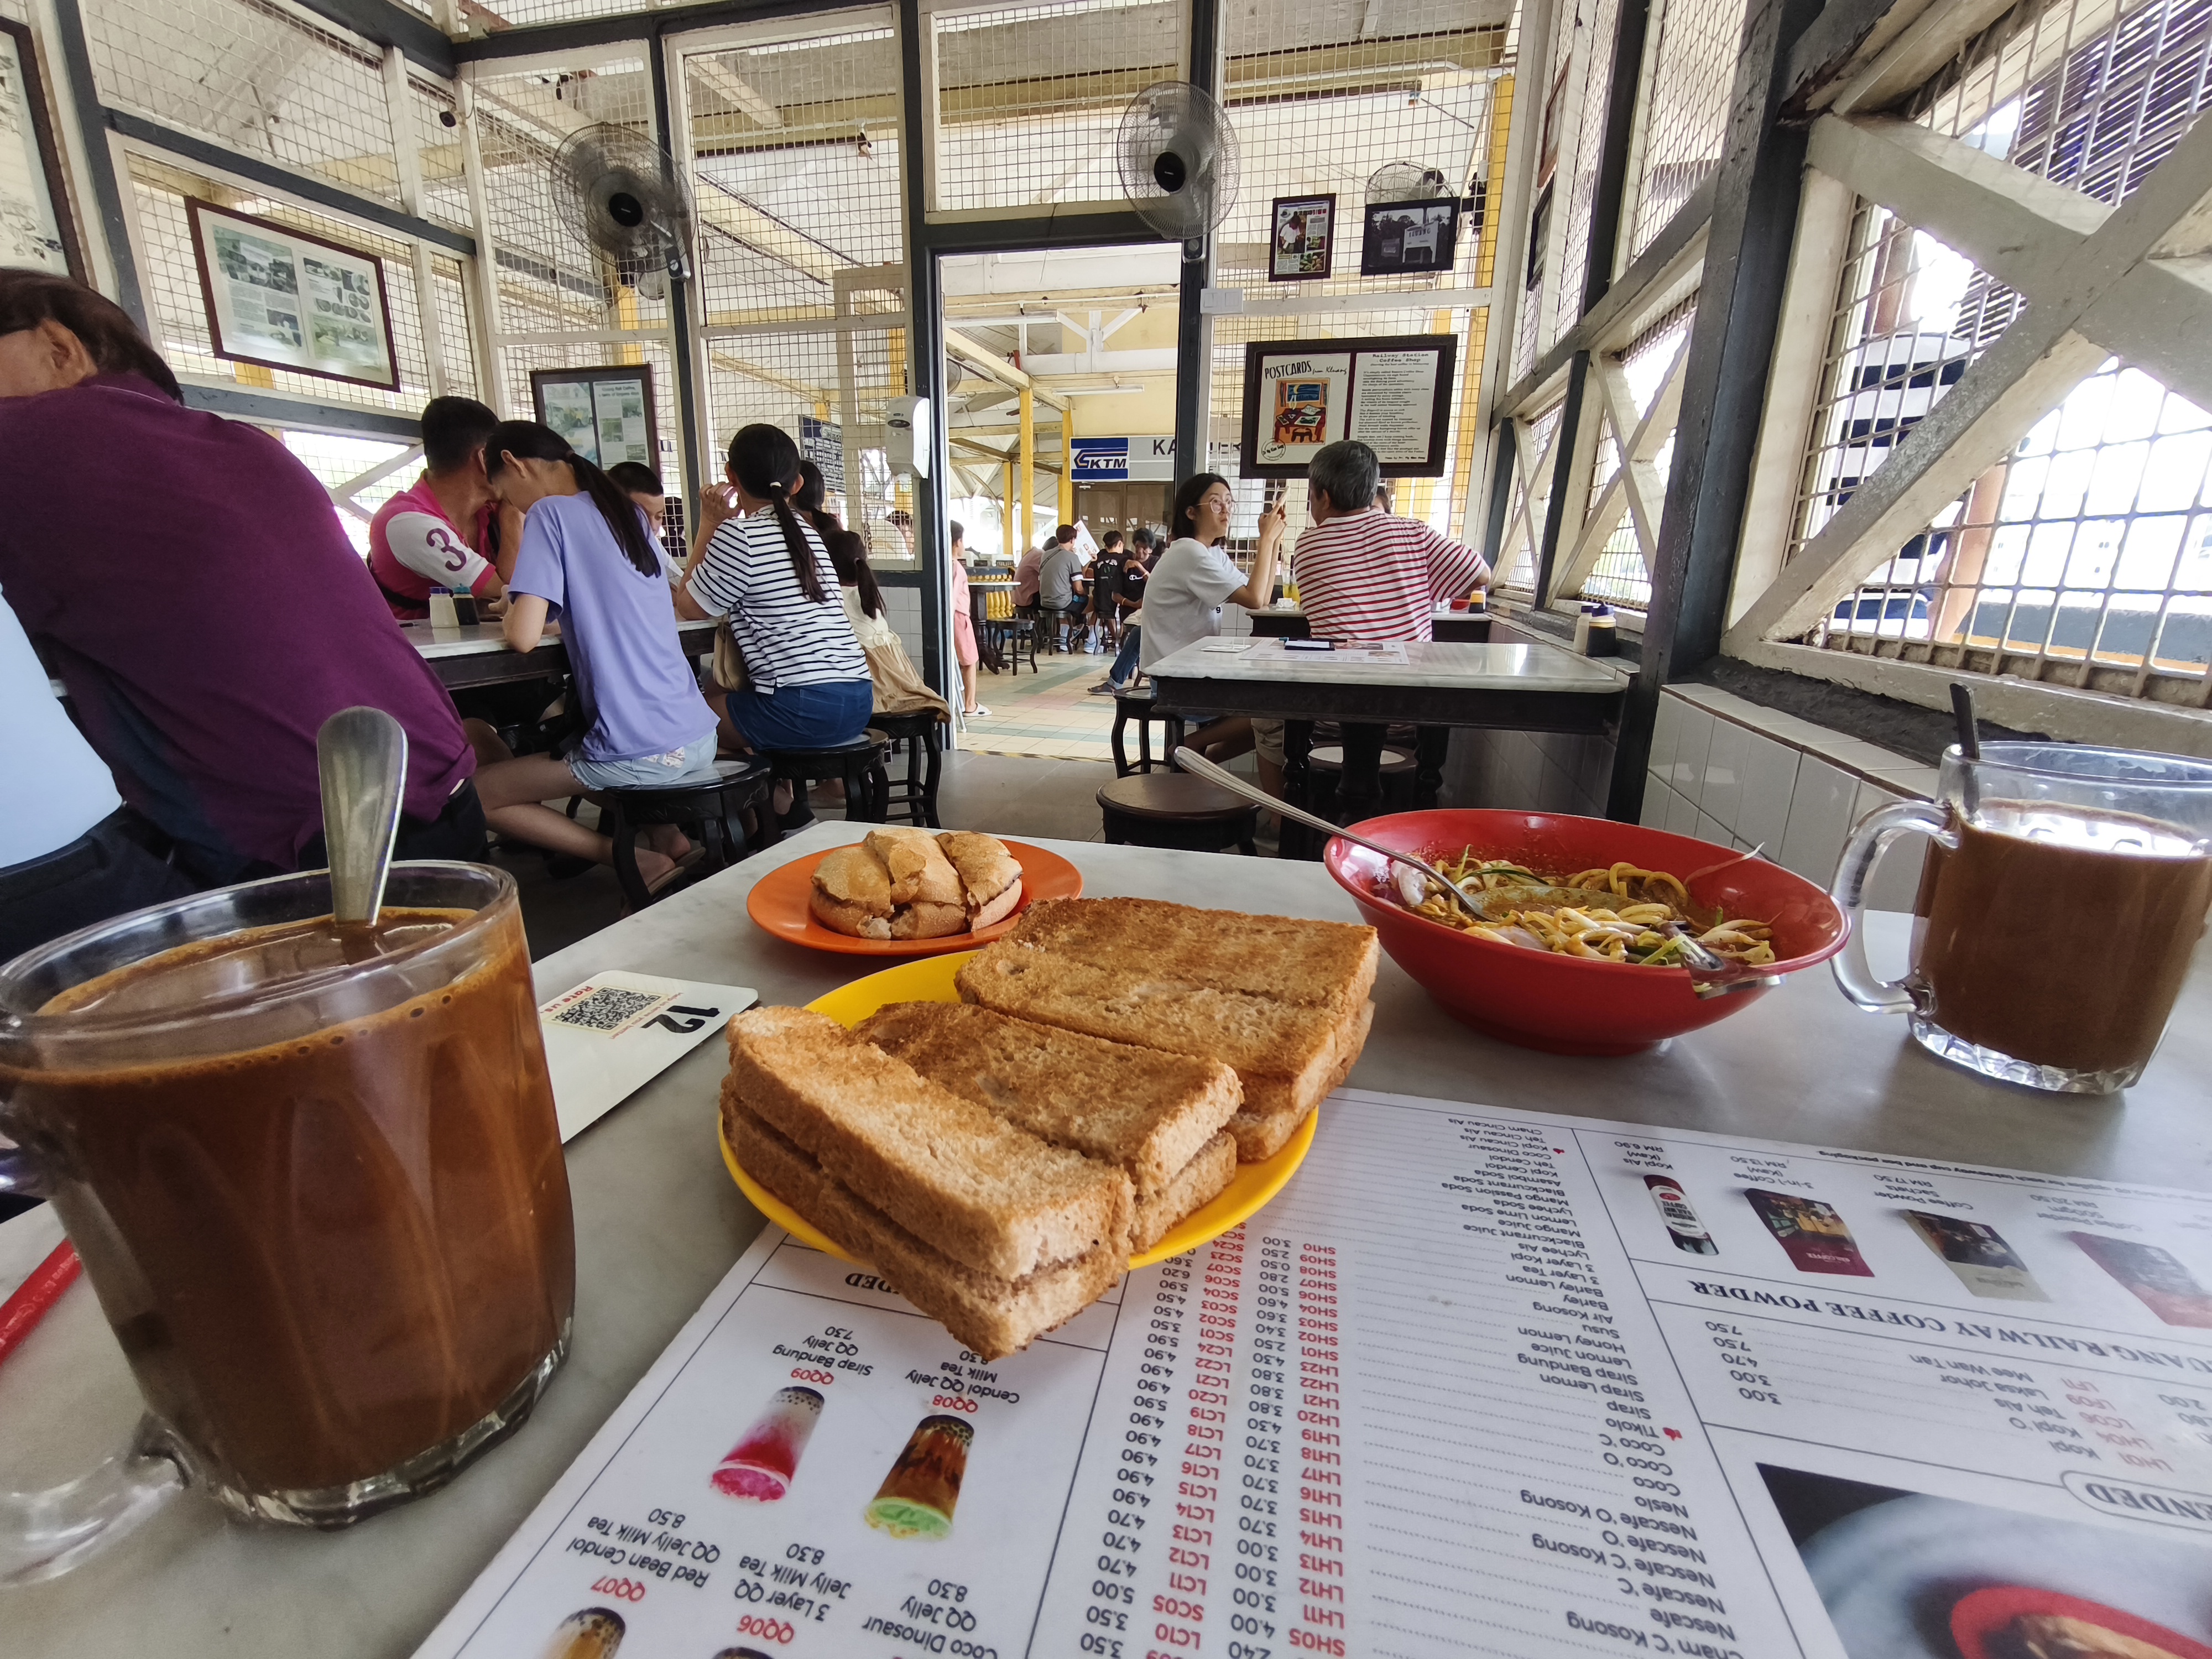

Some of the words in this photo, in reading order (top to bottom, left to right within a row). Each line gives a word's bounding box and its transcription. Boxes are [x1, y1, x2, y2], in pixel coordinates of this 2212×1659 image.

[1265, 361, 1312, 380] POSTCARDS
[1089, 458, 1126, 469] KTM
[426, 528, 467, 571] 3
[640, 1005, 720, 1034] 12
[1463, 1224, 1498, 1236] Juice
[1498, 1219, 1532, 1230] Juice
[1535, 1224, 1580, 1238] Mango
[1500, 1229, 1585, 1249] Blackcurrant
[1518, 1243, 1538, 1252] Ais
[1542, 1246, 1589, 1261] Lychee
[1522, 1266, 1548, 1277] Tea
[1550, 1271, 1587, 1283] Layer
[1590, 1276, 1599, 1285] 3
[845, 1273, 898, 1295] DED
[1506, 1275, 1555, 1290] Lemon
[1559, 1282, 1604, 1297] Barley
[1563, 1295, 1609, 1311] Barley
[1687, 1280, 1822, 1314] POWDER
[1532, 1302, 1589, 1321] Kosong
[1593, 1314, 1613, 1324] Air
[1825, 1302, 1946, 1332] COFFEE
[1150, 1319, 1181, 1333] 3.50
[1200, 1328, 1235, 1342] SC01
[1518, 1327, 1572, 1344] Lemon
[1582, 1324, 1620, 1339] Susu
[802, 1335, 834, 1352] Jelly
[835, 1342, 859, 1356] QQ
[1254, 1338, 1285, 1352] 2.50
[1575, 1335, 1626, 1353] Honey
[1953, 1322, 2110, 1358] RAILWAY
[772, 1344, 835, 1368] Bandung
[1144, 1348, 1176, 1362] 4.90
[1302, 1346, 1338, 1361] SH01
[1531, 1343, 1572, 1359] Juice
[1575, 1351, 1631, 1369] Lemon
[1721, 1353, 1757, 1368] 4.70
[837, 1359, 874, 1376] Sirap
[940, 1362, 963, 1376] Tea
[1195, 1357, 1231, 1373] LC22
[1517, 1353, 1592, 1378] Bandung
[790, 1368, 834, 1385] QQ09
[905, 1369, 939, 1387] Jelly
[940, 1376, 964, 1392] QQ
[967, 1368, 998, 1383] Milk
[1251, 1368, 1285, 1383] 3.80
[1300, 1376, 1339, 1394] LH22
[1540, 1374, 1598, 1394] Lemon
[1595, 1368, 1638, 1385] Sirap
[1730, 1370, 1771, 1386] 3.00
[1991, 1368, 2034, 1383] Mee
[967, 1384, 1020, 1404] Cendol
[1601, 1384, 1645, 1402] Sirap
[1739, 1387, 1782, 1405] 3.00
[932, 1395, 978, 1413] QQ08
[1606, 1401, 1651, 1420] Sirap
[1130, 1412, 1165, 1429] 4.90
[1605, 1418, 1660, 1438] Tikolo
[1187, 1424, 1223, 1442] LC18
[1246, 1436, 1280, 1453] 3.70
[1619, 1438, 1665, 1456] Coco
[1301, 1447, 1340, 1466] LH18
[1626, 1457, 1673, 1476] Coco
[1117, 1468, 1154, 1486] 4.90
[1632, 1477, 1681, 1496] Coco
[1113, 1488, 1151, 1508] 4.90
[1178, 1481, 1217, 1501] LC15
[1175, 1502, 1214, 1523] LC14
[1241, 1495, 1277, 1515] 3.70
[1520, 1489, 1591, 1519] Kosong
[1634, 1496, 1689, 1519] Neslo
[587, 1517, 614, 1536] Tea
[648, 1509, 686, 1528] 8.50
[1108, 1510, 1145, 1530] 4.70
[1239, 1516, 1276, 1538] 3.70
[1299, 1508, 1342, 1530] LH15
[1620, 1512, 1698, 1541] Nescafe
[615, 1524, 653, 1546] Milk
[653, 1531, 692, 1556] Jelly
[1103, 1532, 1141, 1553] 4.70
[1172, 1525, 1212, 1547] LC13
[1300, 1530, 1343, 1553] LH14
[565, 1537, 626, 1565] Cendol
[691, 1541, 720, 1563] QQ
[786, 1543, 825, 1566] 8.30
[1168, 1547, 1209, 1571] LC12
[1237, 1539, 1278, 1562] 3.00
[1532, 1533, 1607, 1566] Kosong
[1627, 1535, 1707, 1564] Nescafe
[629, 1553, 672, 1578] Bean
[739, 1556, 767, 1578] Tea
[1098, 1556, 1137, 1578] 4.70
[1235, 1563, 1277, 1587] 3.00
[1299, 1553, 1343, 1577] LH13
[1634, 1558, 1716, 1589] Nescafe
[670, 1566, 711, 1588] Red
[771, 1564, 809, 1588] Milk
[810, 1572, 851, 1599] Jelly
[1169, 1572, 1207, 1596] LC11
[591, 1576, 645, 1602] QQ07
[734, 1579, 764, 1603] QQ
[927, 1579, 968, 1603] 8.30
[1092, 1580, 1135, 1605] 5.00
[1298, 1578, 1343, 1604] LH12
[1642, 1583, 1726, 1615] Nescafe
[765, 1590, 815, 1618] Layer
[900, 1596, 943, 1624] Jelly
[1152, 1595, 1204, 1622] SC05
[1233, 1588, 1276, 1613] 3.00
[815, 1604, 830, 1622] 3
[946, 1607, 976, 1632] QQ
[1303, 1604, 1344, 1630] LH11
[737, 1615, 794, 1644] QQ06
[862, 1616, 946, 1653] Dinosaur
[1230, 1613, 1275, 1639] 4.00
[1566, 1611, 1648, 1648] Kosong
[1650, 1609, 1736, 1641] Nescafe
[1288, 1628, 1345, 1657] SH05
